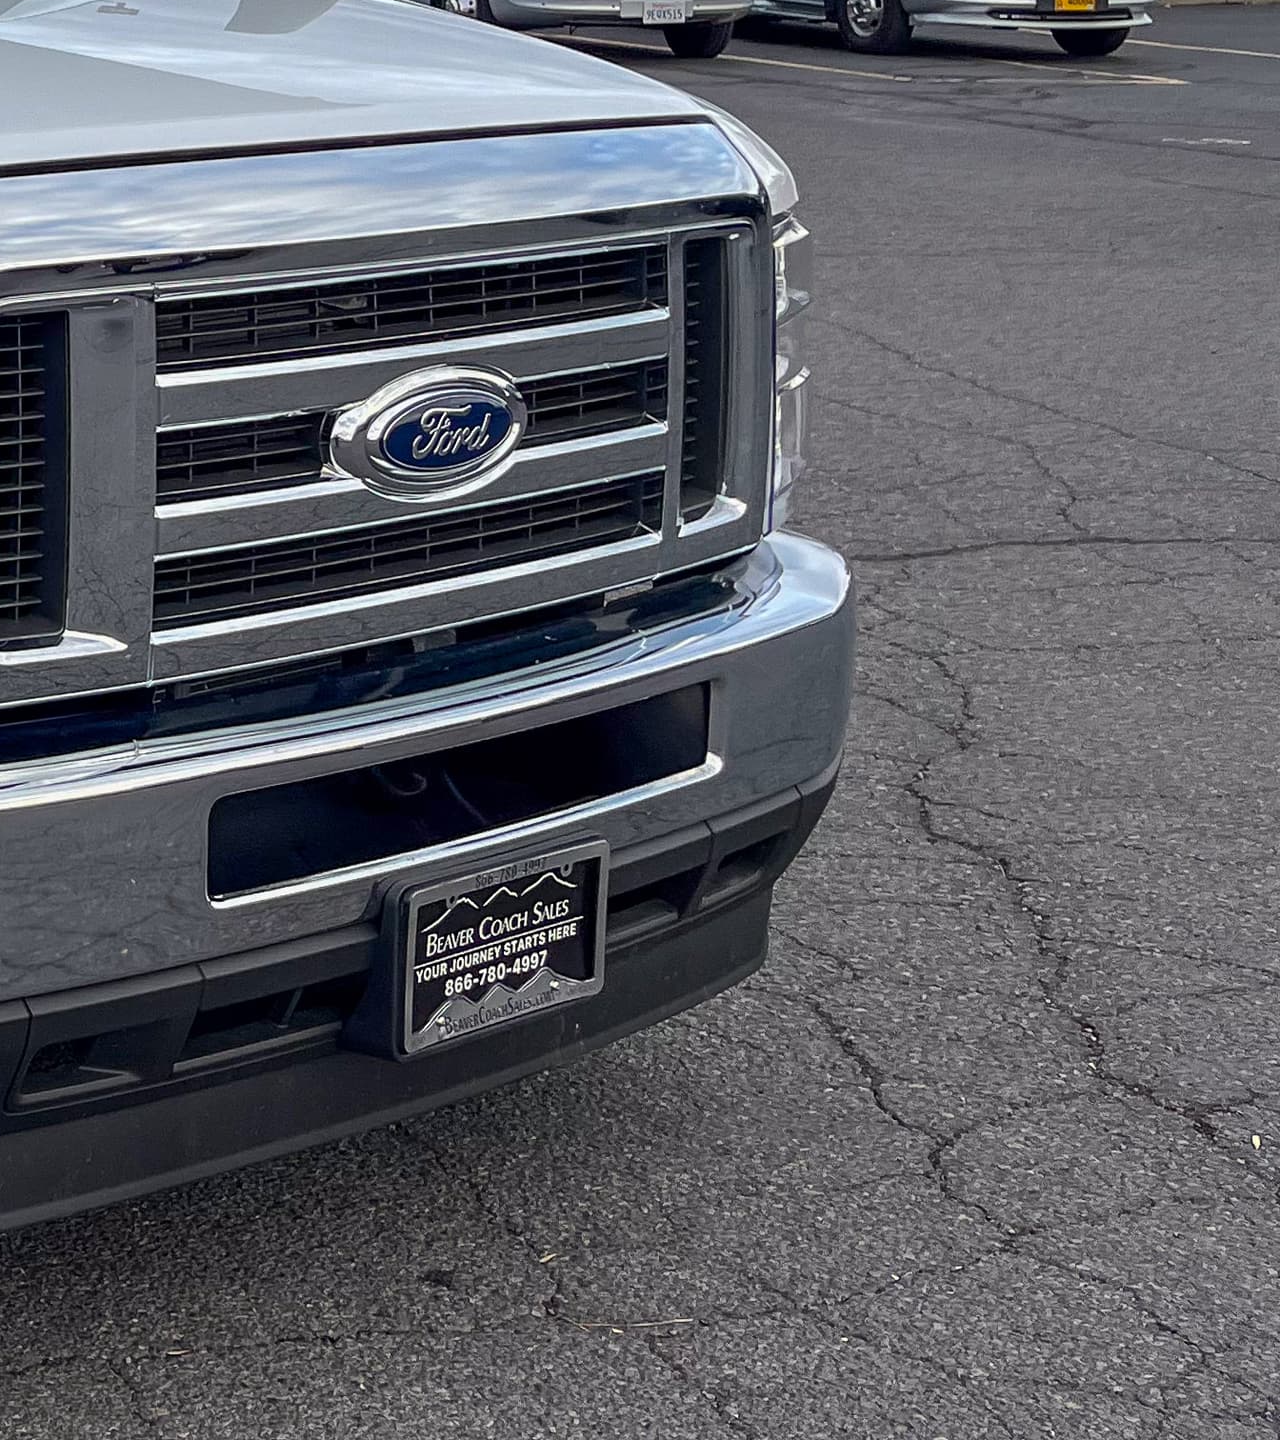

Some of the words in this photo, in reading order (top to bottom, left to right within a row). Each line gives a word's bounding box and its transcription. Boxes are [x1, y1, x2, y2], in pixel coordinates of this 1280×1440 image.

[412, 404, 492, 459] Ford
[416, 962, 447, 984] YOUR
[449, 945, 503, 973] JOURNEY
[503, 932, 546, 956] STARTS
[548, 922, 577, 943] HERE
[426, 927, 474, 957] BEAVER
[479, 911, 528, 940] COACH
[532, 899, 569, 925] SALES
[444, 950, 548, 996] 866-780-4997
